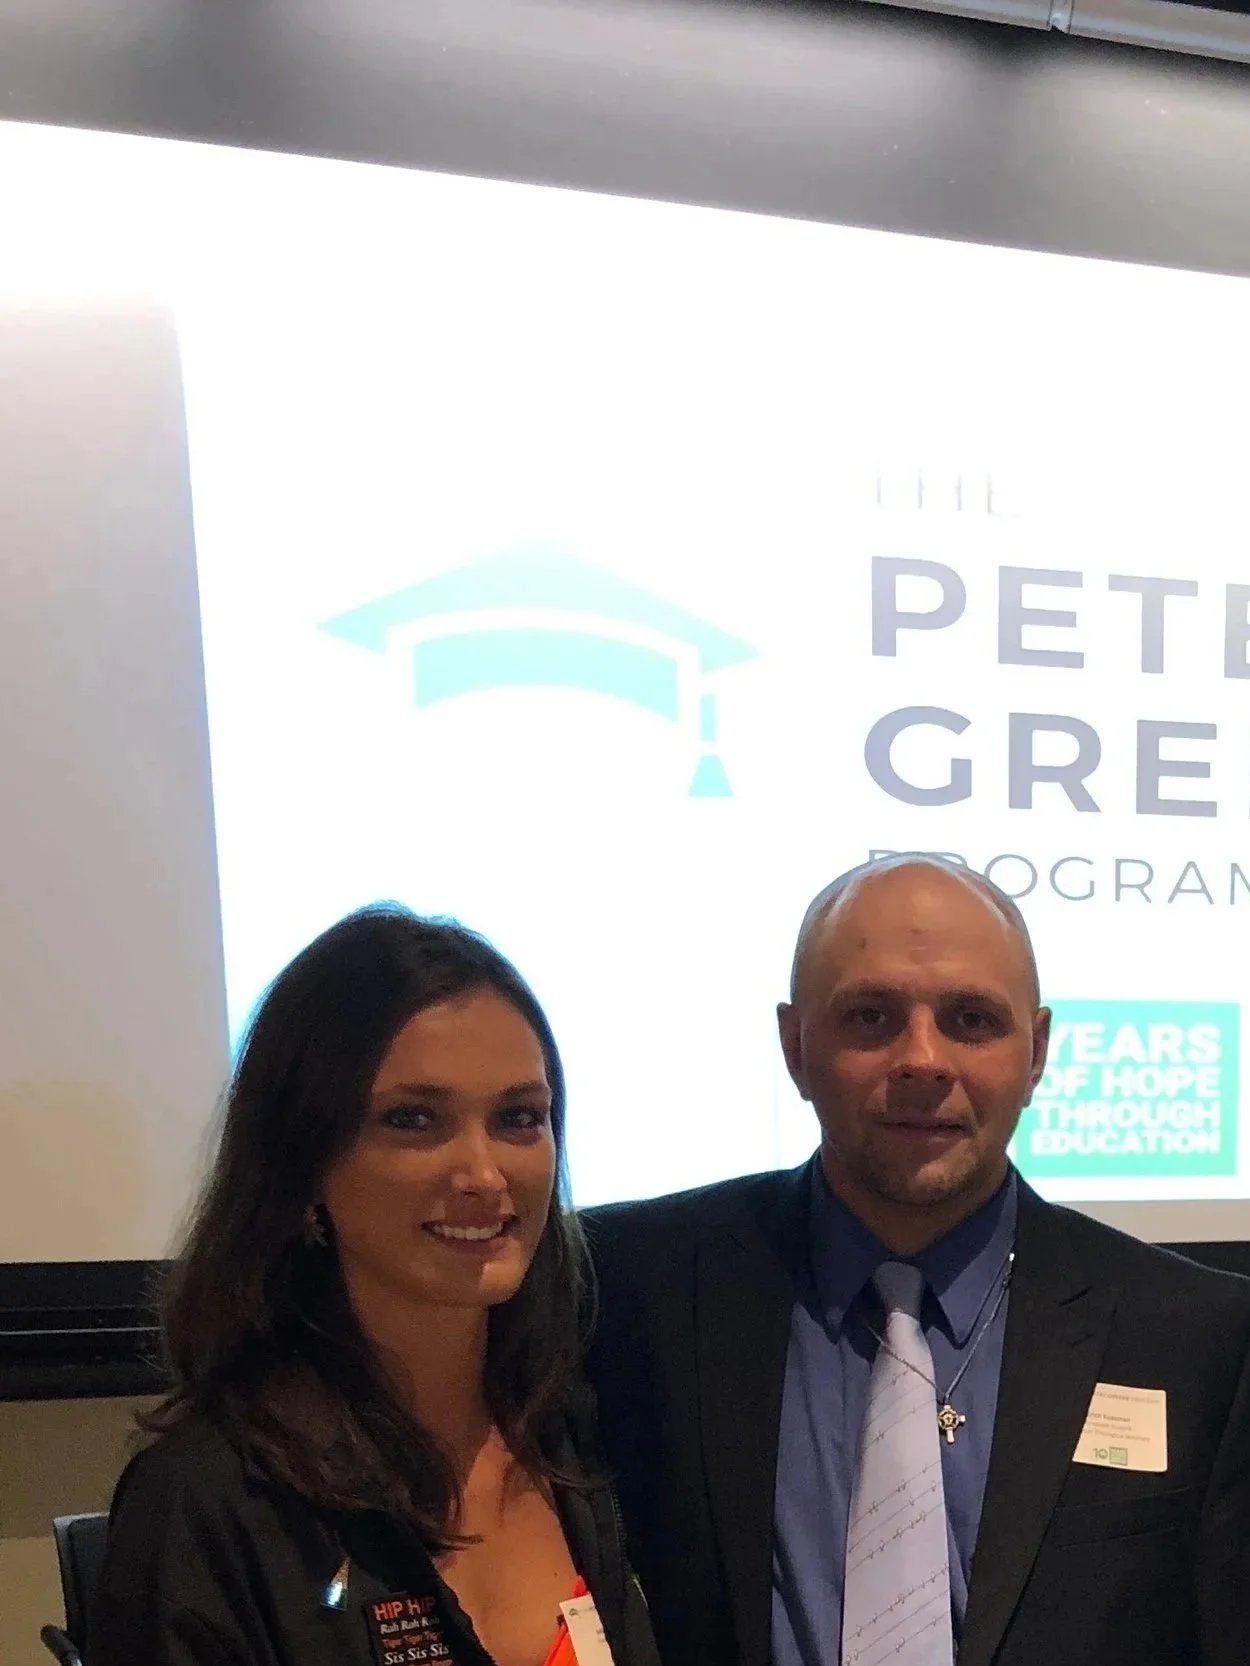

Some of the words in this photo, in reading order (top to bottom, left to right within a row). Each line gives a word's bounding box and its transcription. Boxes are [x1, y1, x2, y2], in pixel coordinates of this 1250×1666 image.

[1034, 1064, 1090, 1099] OF
[1101, 1064, 1222, 1099] HOPE
[1034, 1100, 1222, 1129] THROUGH
[1029, 1128, 1222, 1156] EDUCATION
[373, 1601, 403, 1621] HIP
[380, 1622, 400, 1635] Rah
[401, 1618, 420, 1631] Rah
[384, 1651, 405, 1665] Sis
[407, 1647, 428, 1661] Sis
[430, 1642, 450, 1657] Sis
